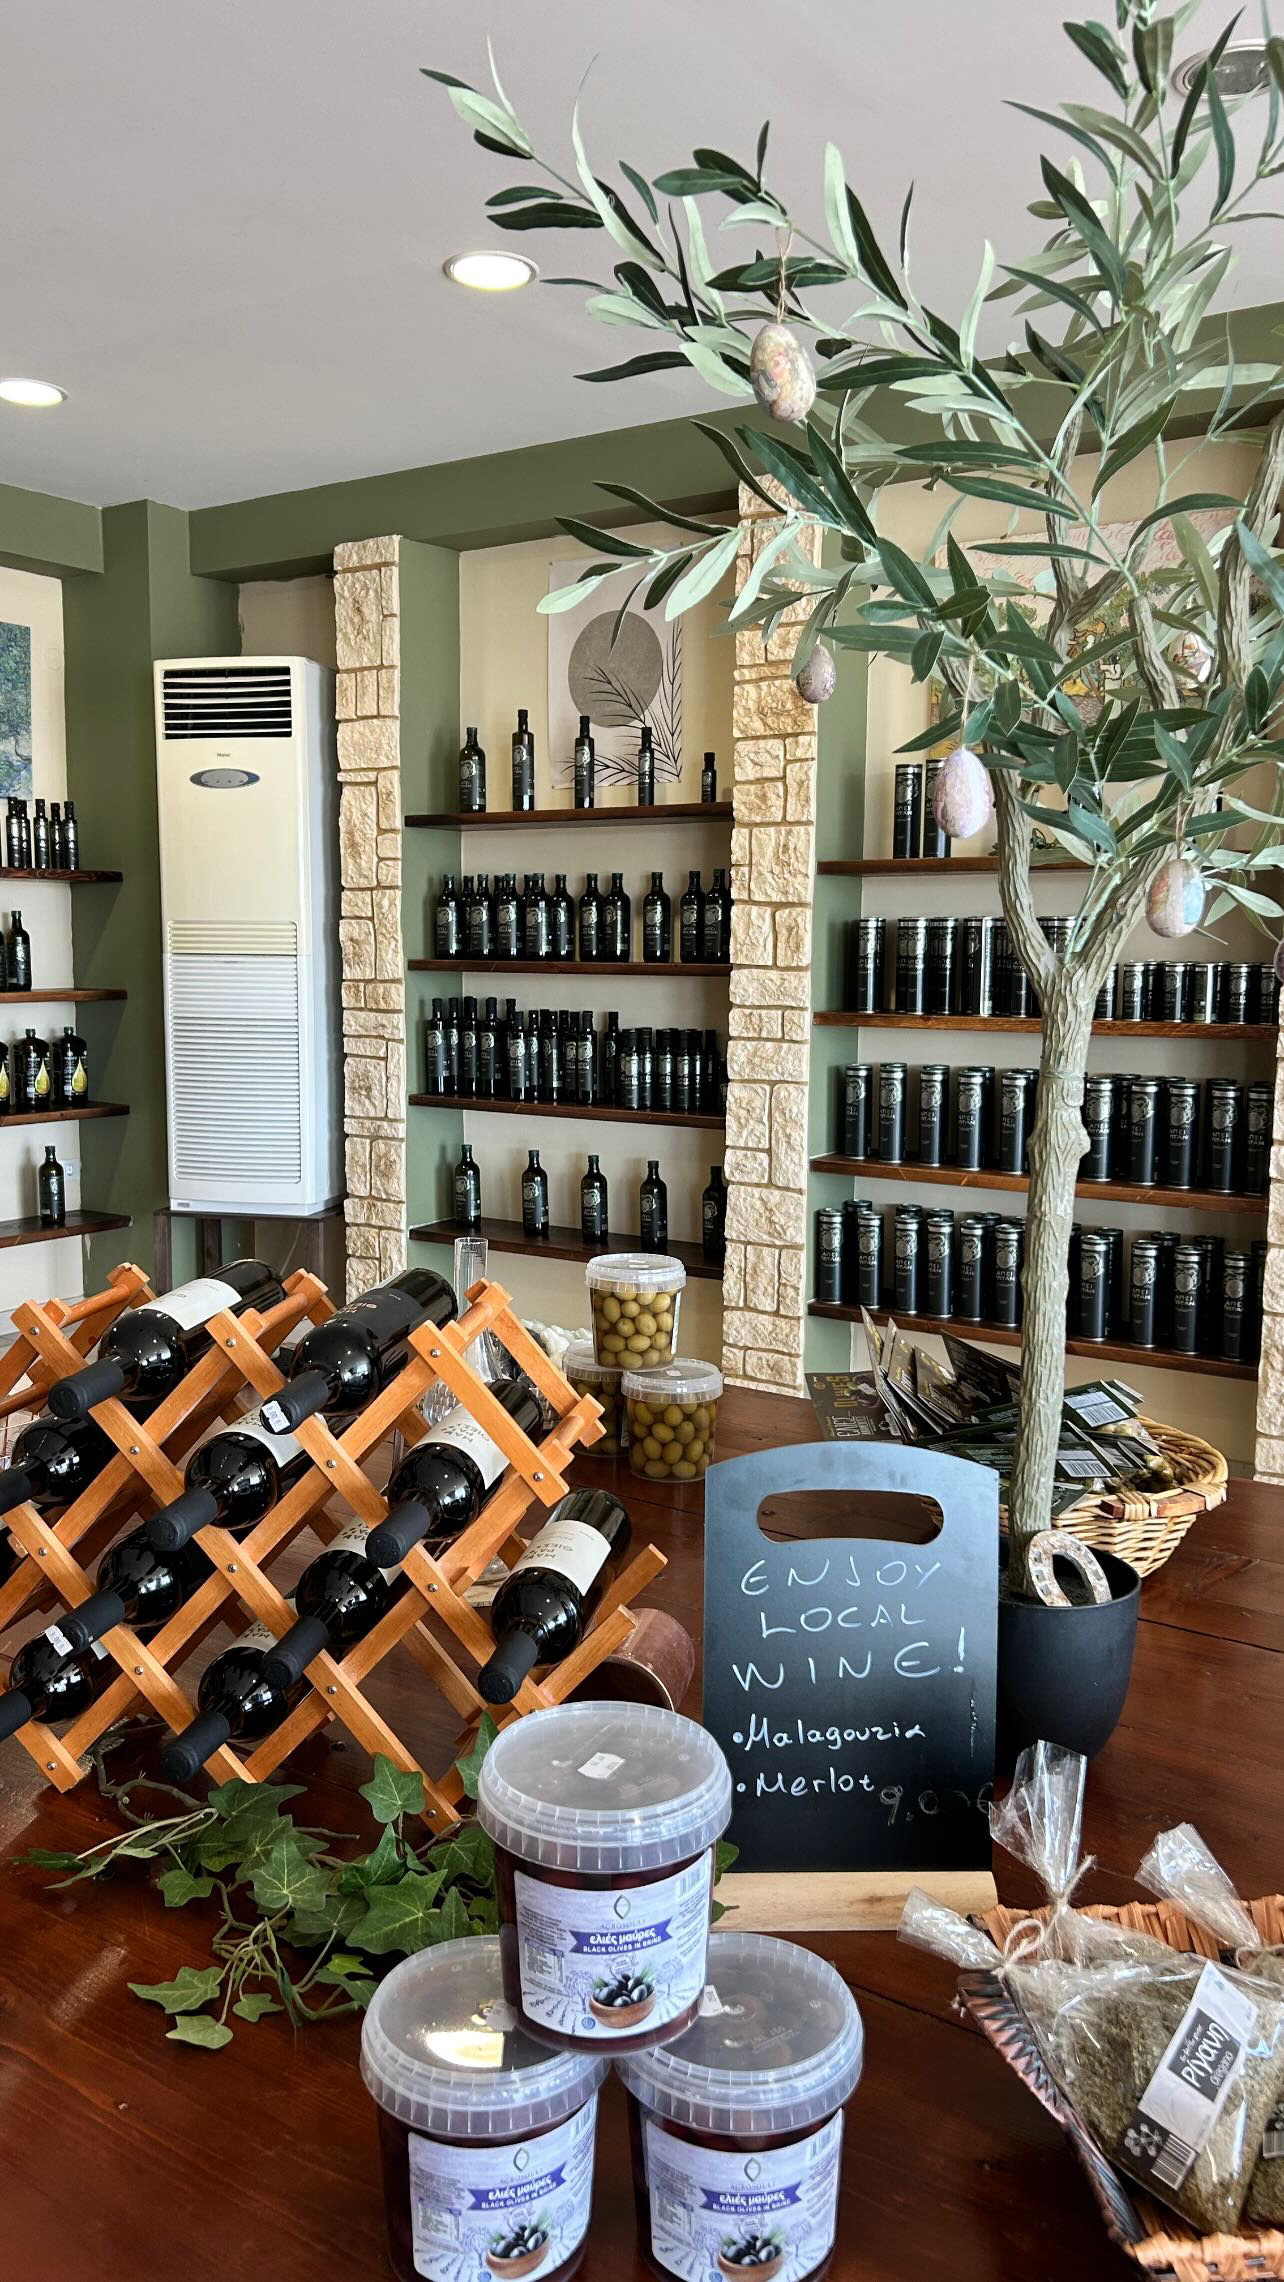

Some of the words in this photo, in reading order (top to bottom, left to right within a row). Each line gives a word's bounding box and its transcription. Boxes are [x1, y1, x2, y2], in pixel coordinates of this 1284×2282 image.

[740, 1556, 942, 1596] ENJOY
[759, 1604, 928, 1638] LOCAL
[732, 1627, 966, 1692] WINE!
[757, 1766, 874, 1797] Merlot
[590, 1932, 617, 1946] ελιές
[619, 1928, 656, 1944] μαύρες
[608, 1944, 632, 1952] OLIVES
[1181, 2022, 1230, 2088] Ρίγανη
[488, 2186, 516, 2200] ελιές
[720, 2193, 747, 2206] ελιές
[748, 2190, 785, 2206] μαύρες
